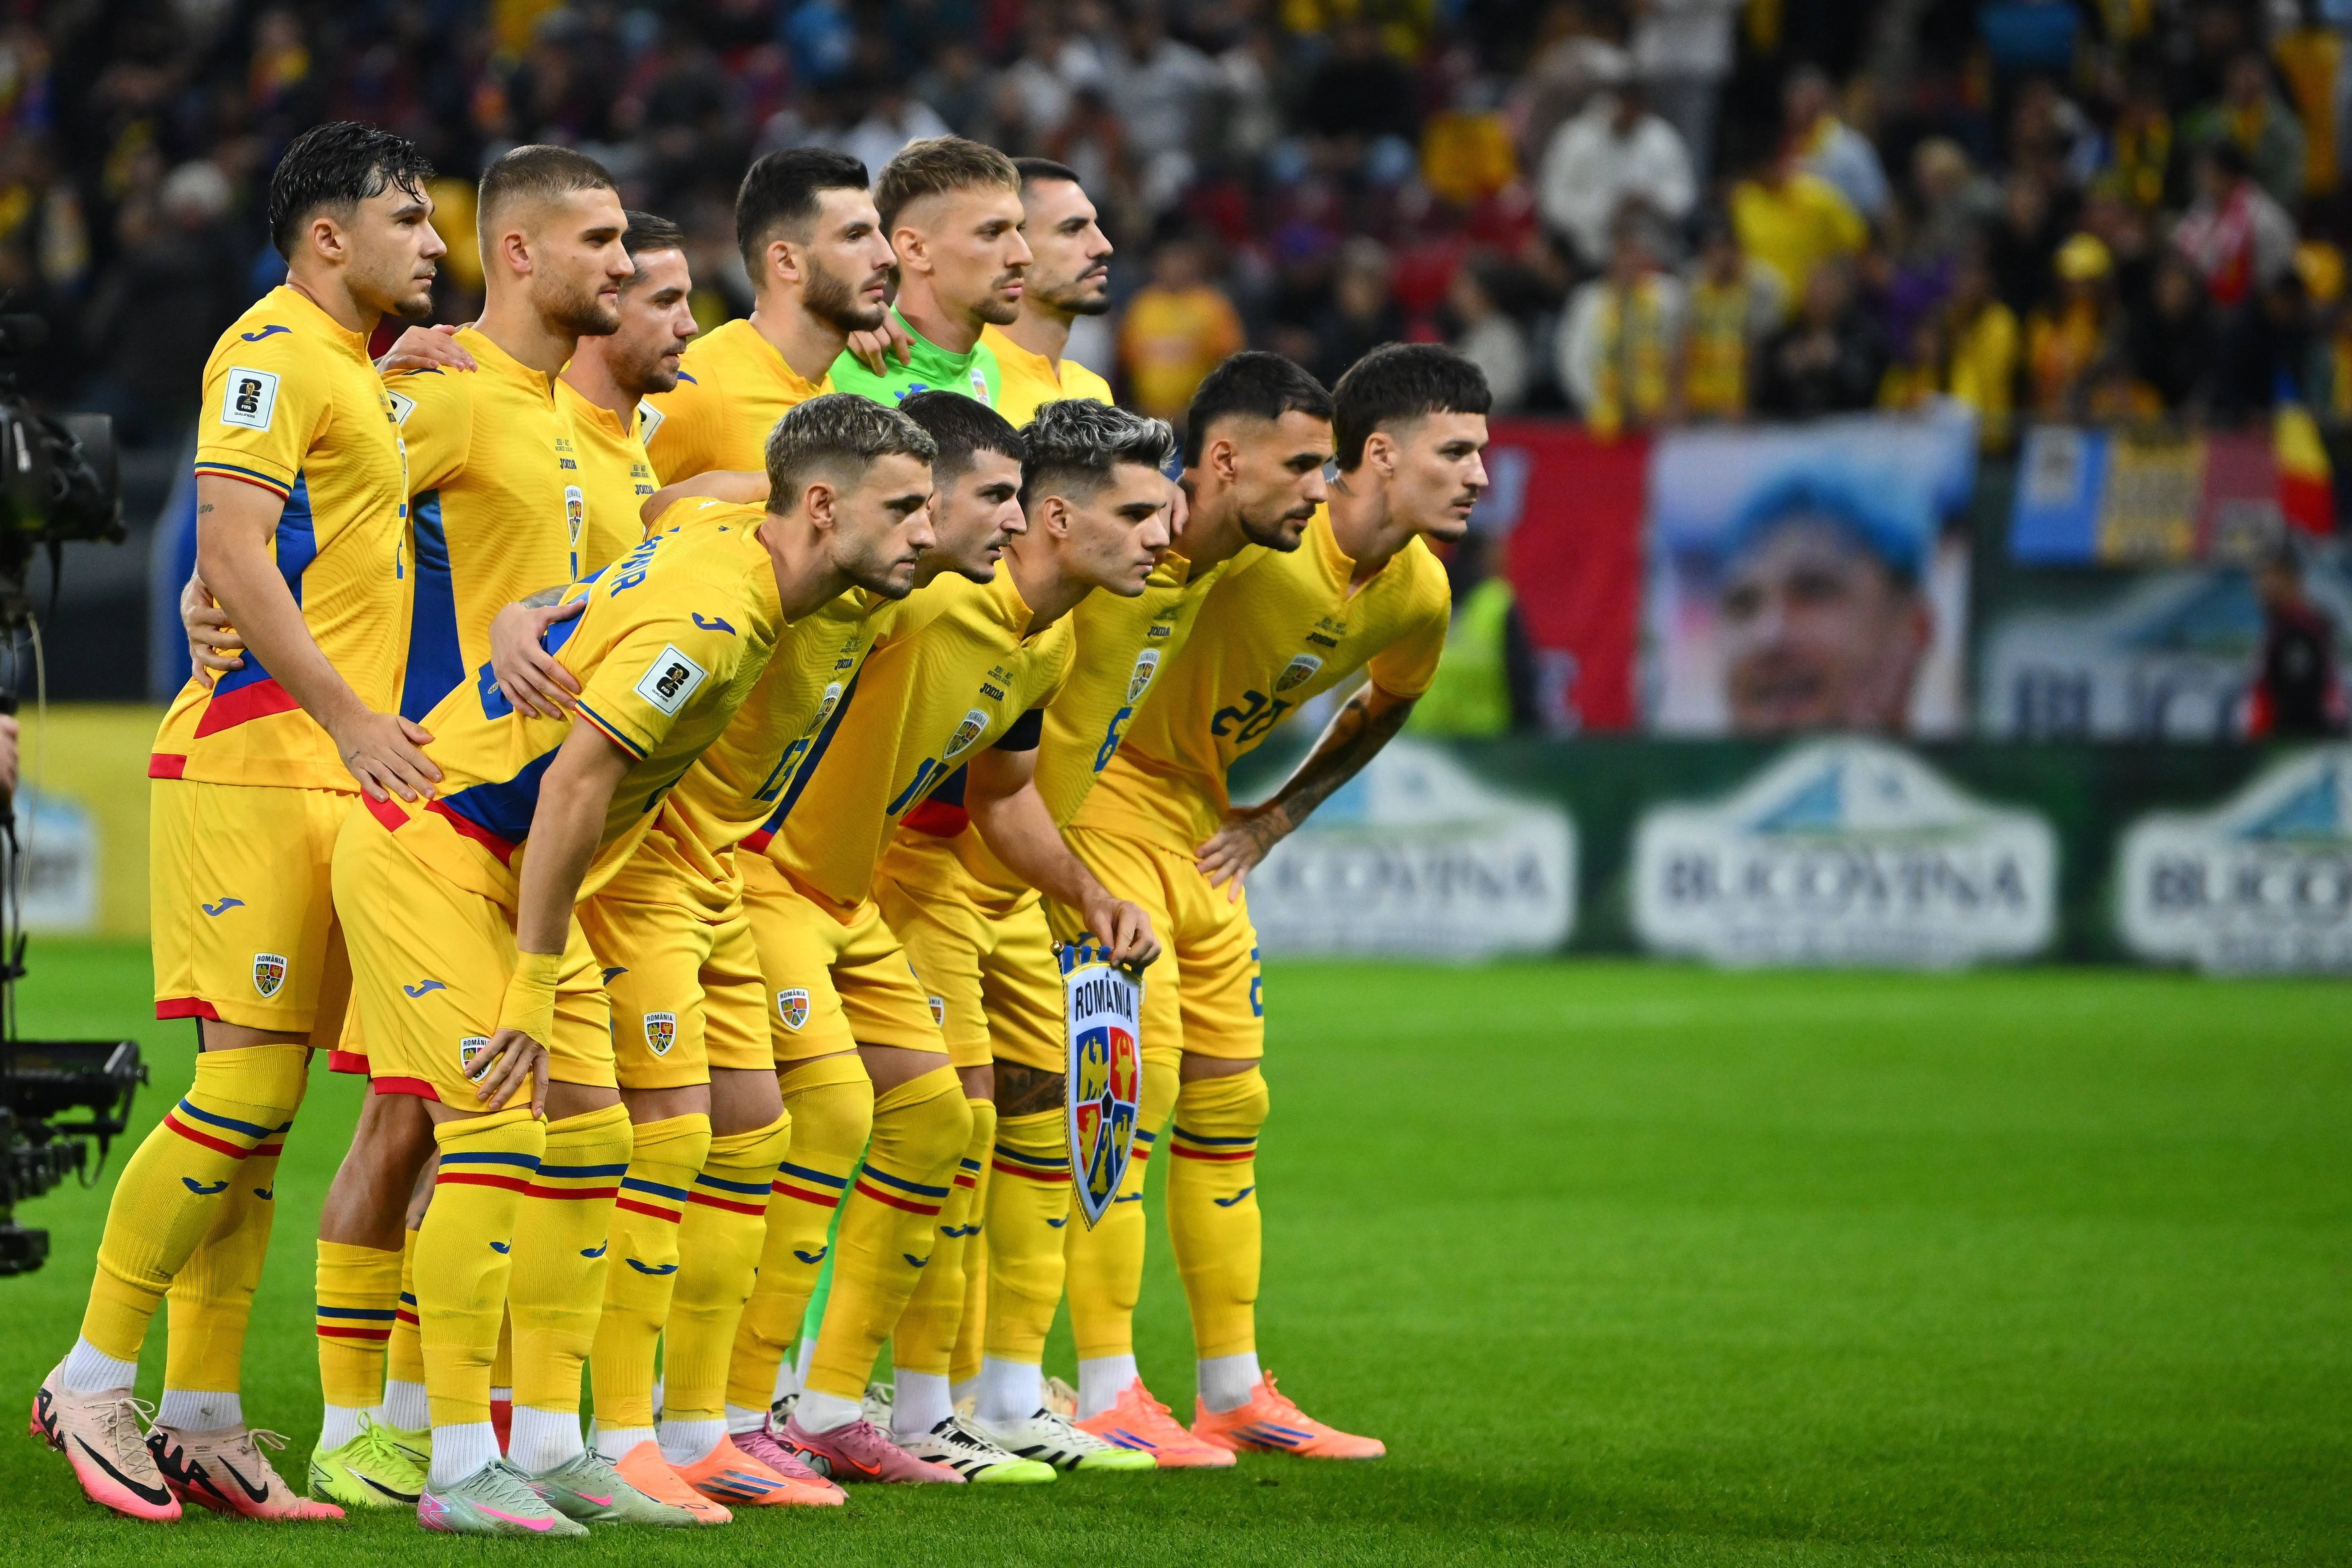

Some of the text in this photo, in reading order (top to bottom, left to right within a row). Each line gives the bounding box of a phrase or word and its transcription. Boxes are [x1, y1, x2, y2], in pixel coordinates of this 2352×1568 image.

[661, 685, 671, 695] FIFA
[651, 688, 669, 703] QUALIFIERS
[1211, 689, 1293, 743] 20
[1094, 706, 1133, 772] 6
[257, 955, 284, 965] ROMÂNIA
[779, 989, 805, 999] ROMÂNIA
[1075, 970, 1133, 1023] ROMÂNIA
[647, 1013, 673, 1022] ROMÂNIA
[463, 1038, 490, 1047] ROMÂNI
